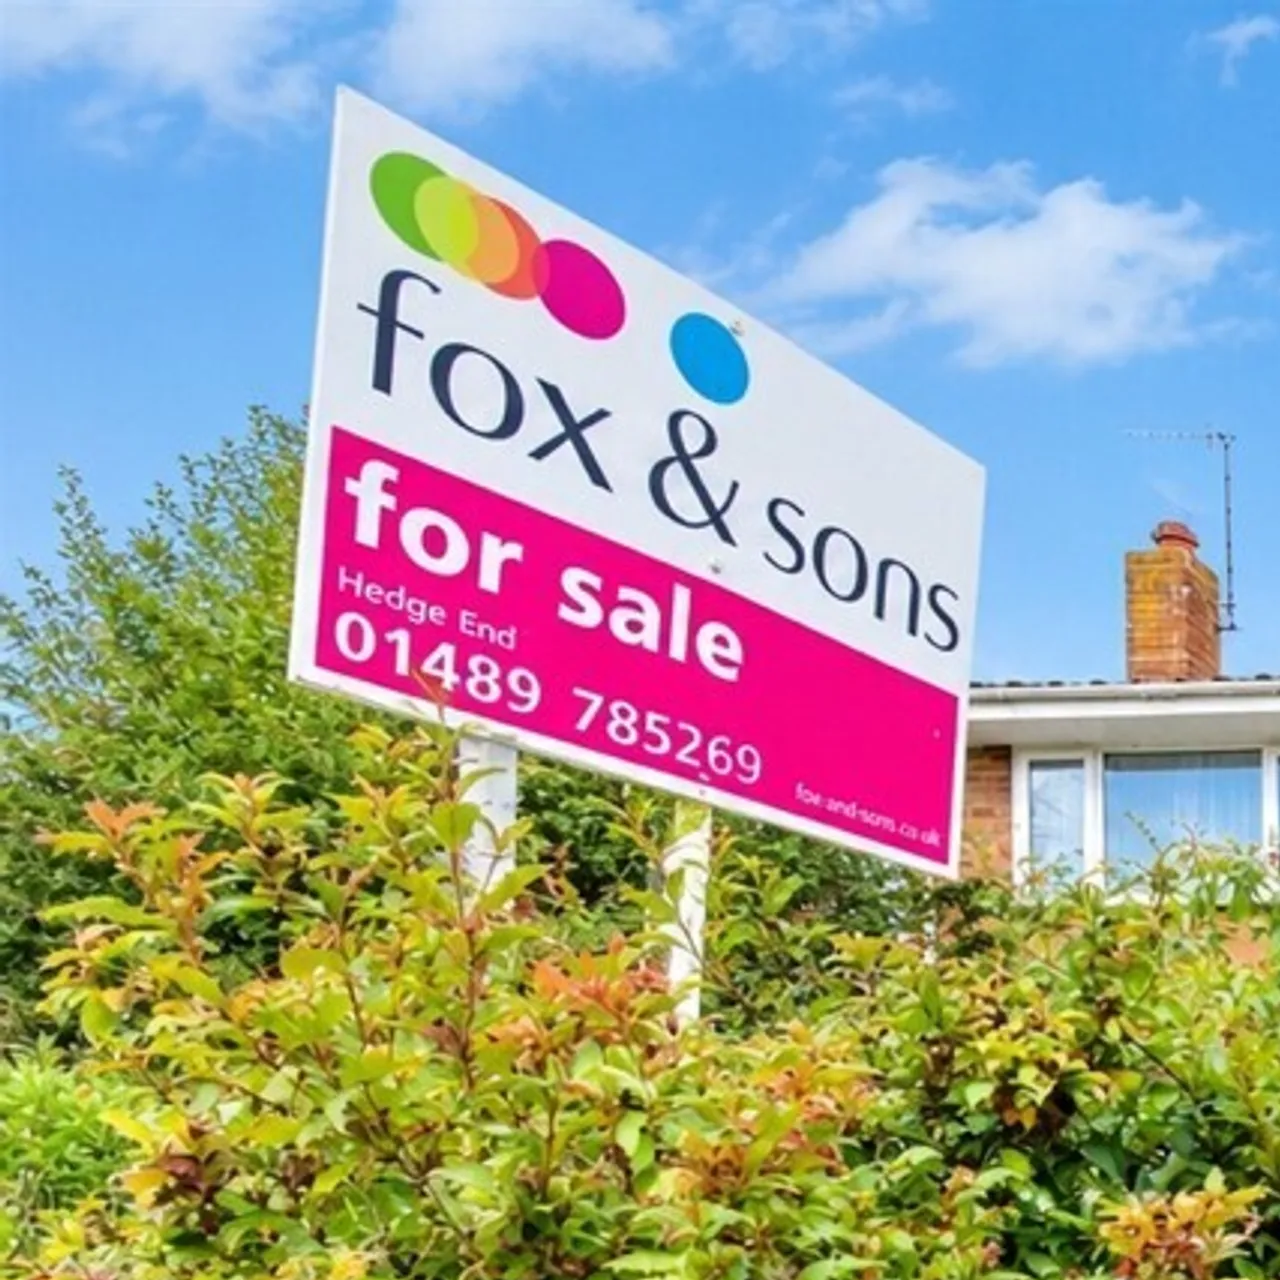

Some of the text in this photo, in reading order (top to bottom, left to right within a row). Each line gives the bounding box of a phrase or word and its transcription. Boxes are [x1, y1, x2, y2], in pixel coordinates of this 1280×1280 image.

[357, 270, 960, 652] fox & sons
[338, 566, 517, 650] Hedge End
[344, 459, 744, 682] for sale
[335, 611, 762, 784] 01489 785269
